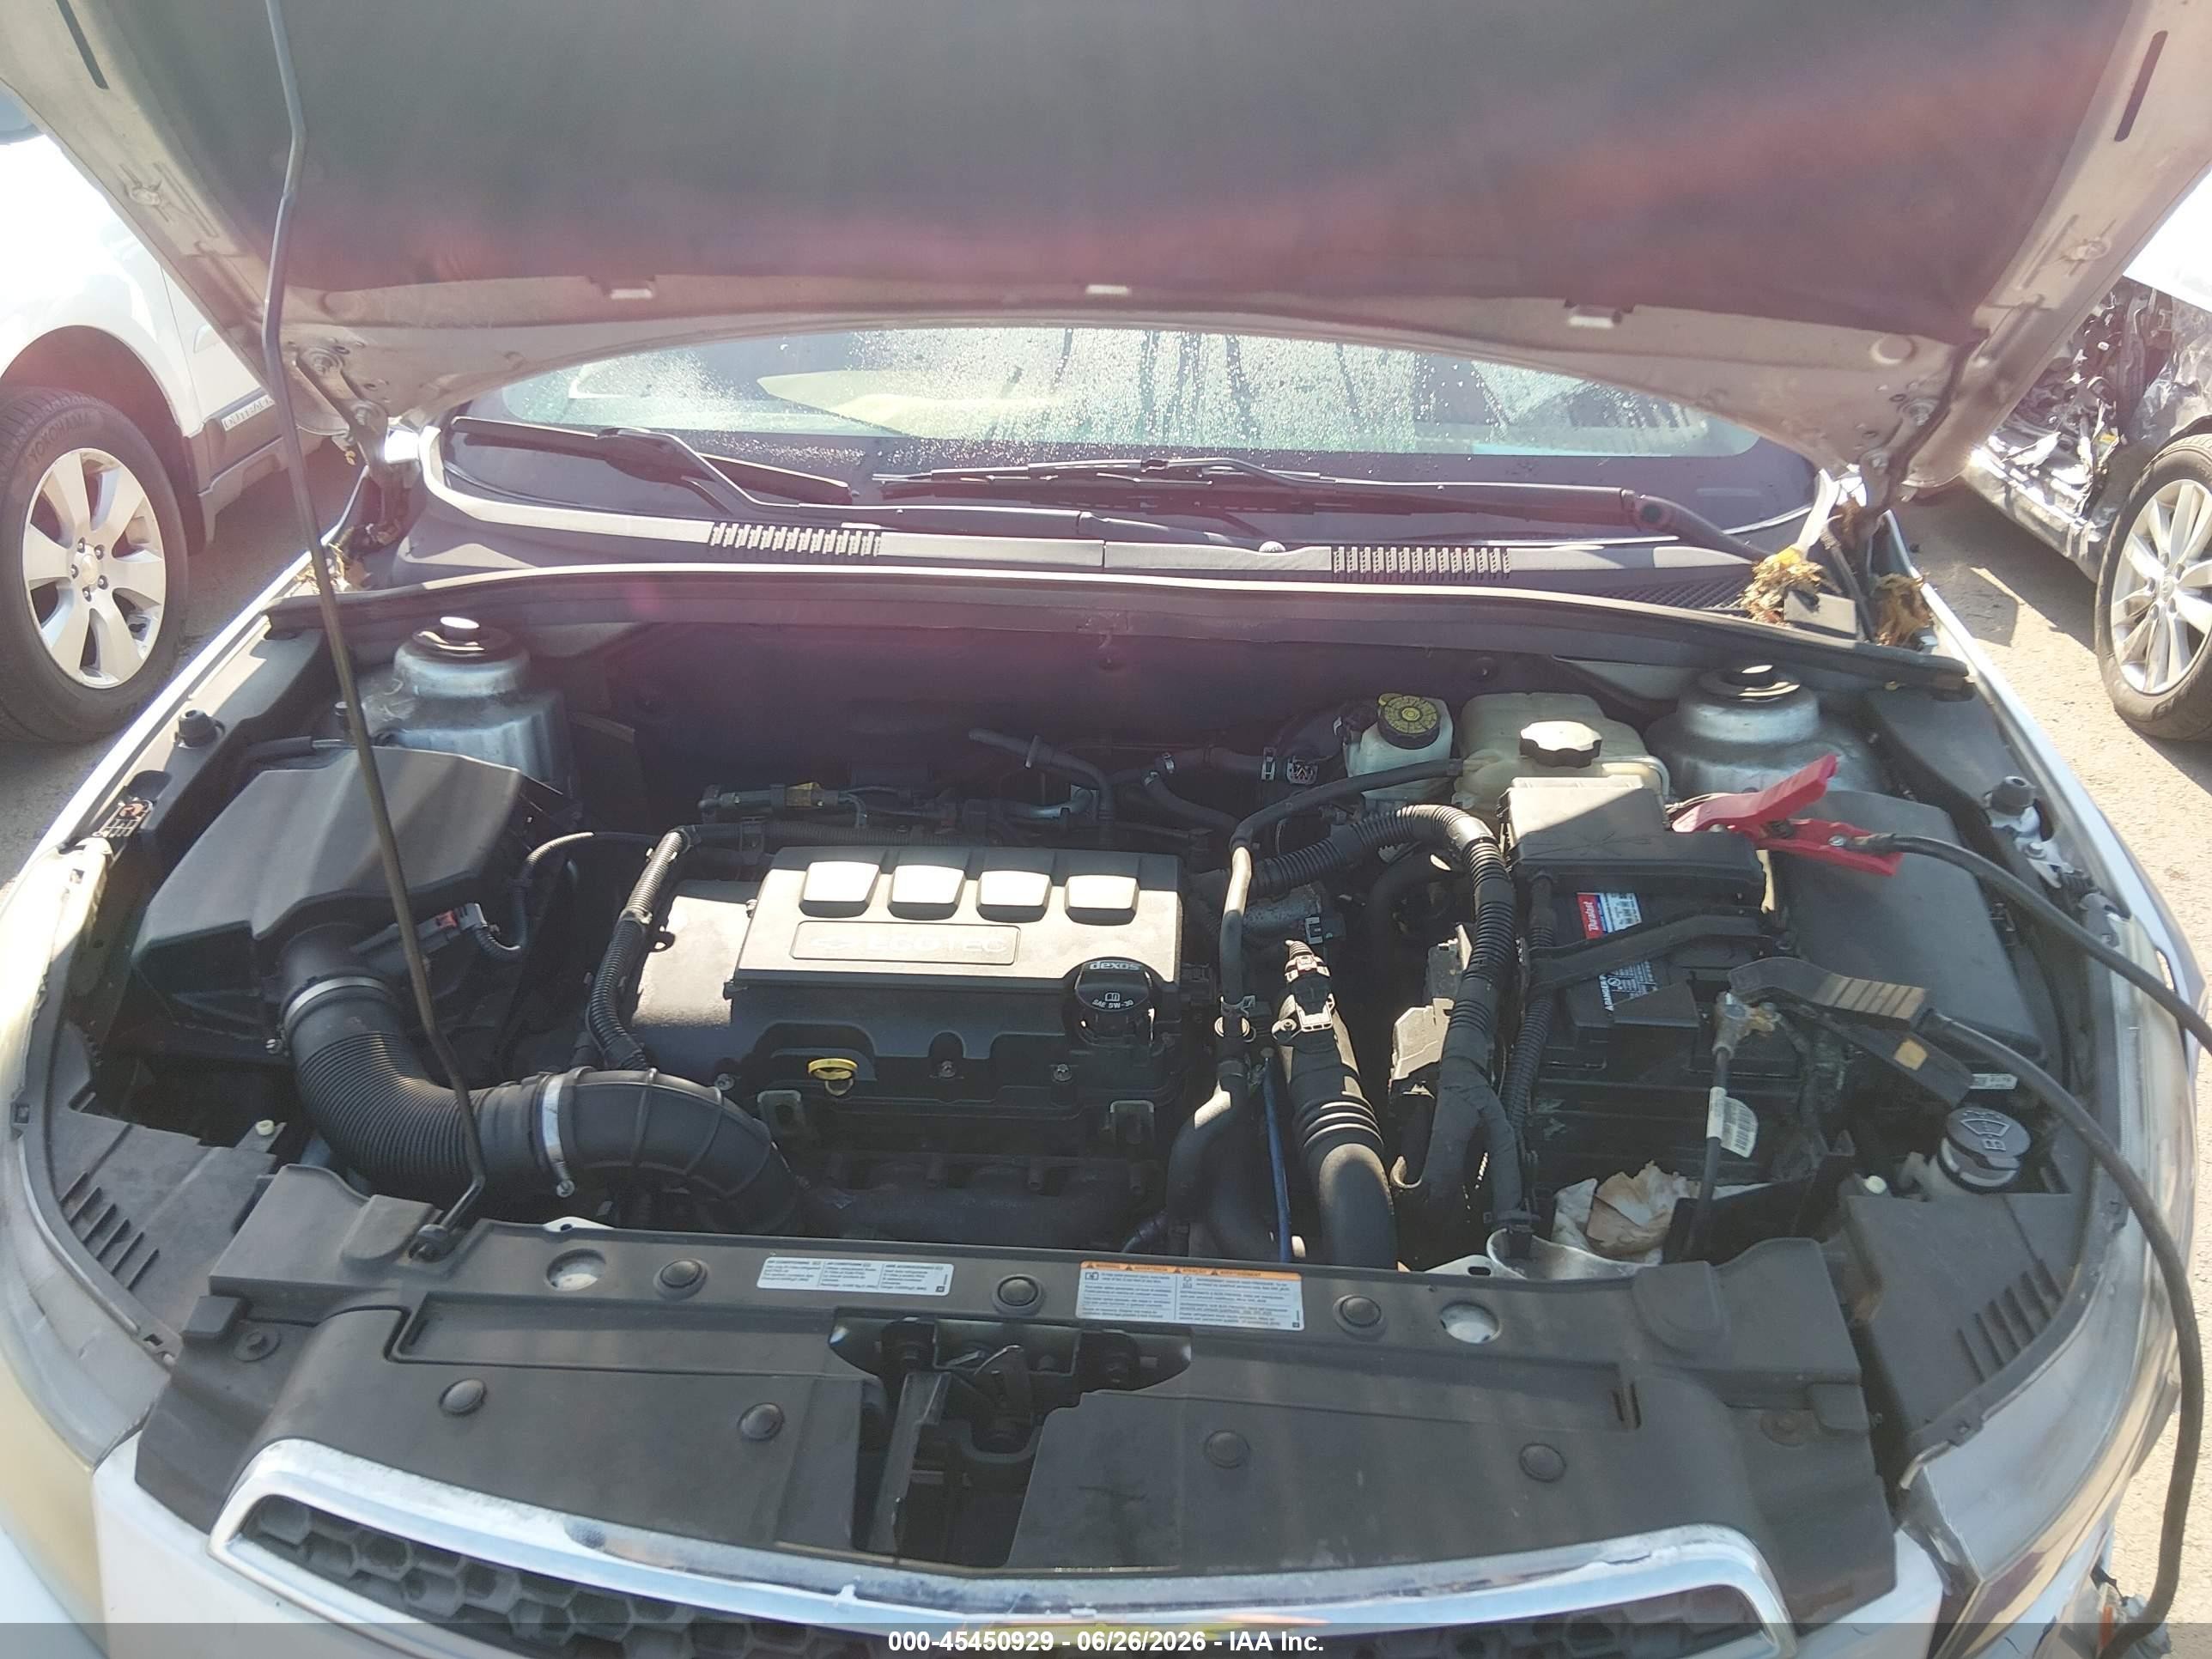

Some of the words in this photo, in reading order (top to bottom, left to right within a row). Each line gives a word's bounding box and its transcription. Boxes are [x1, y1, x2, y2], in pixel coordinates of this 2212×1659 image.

[1089, 961, 1141, 971] dexos
[1091, 999, 1107, 1008] SAE
[1108, 1000, 1134, 1009] 5W-30
